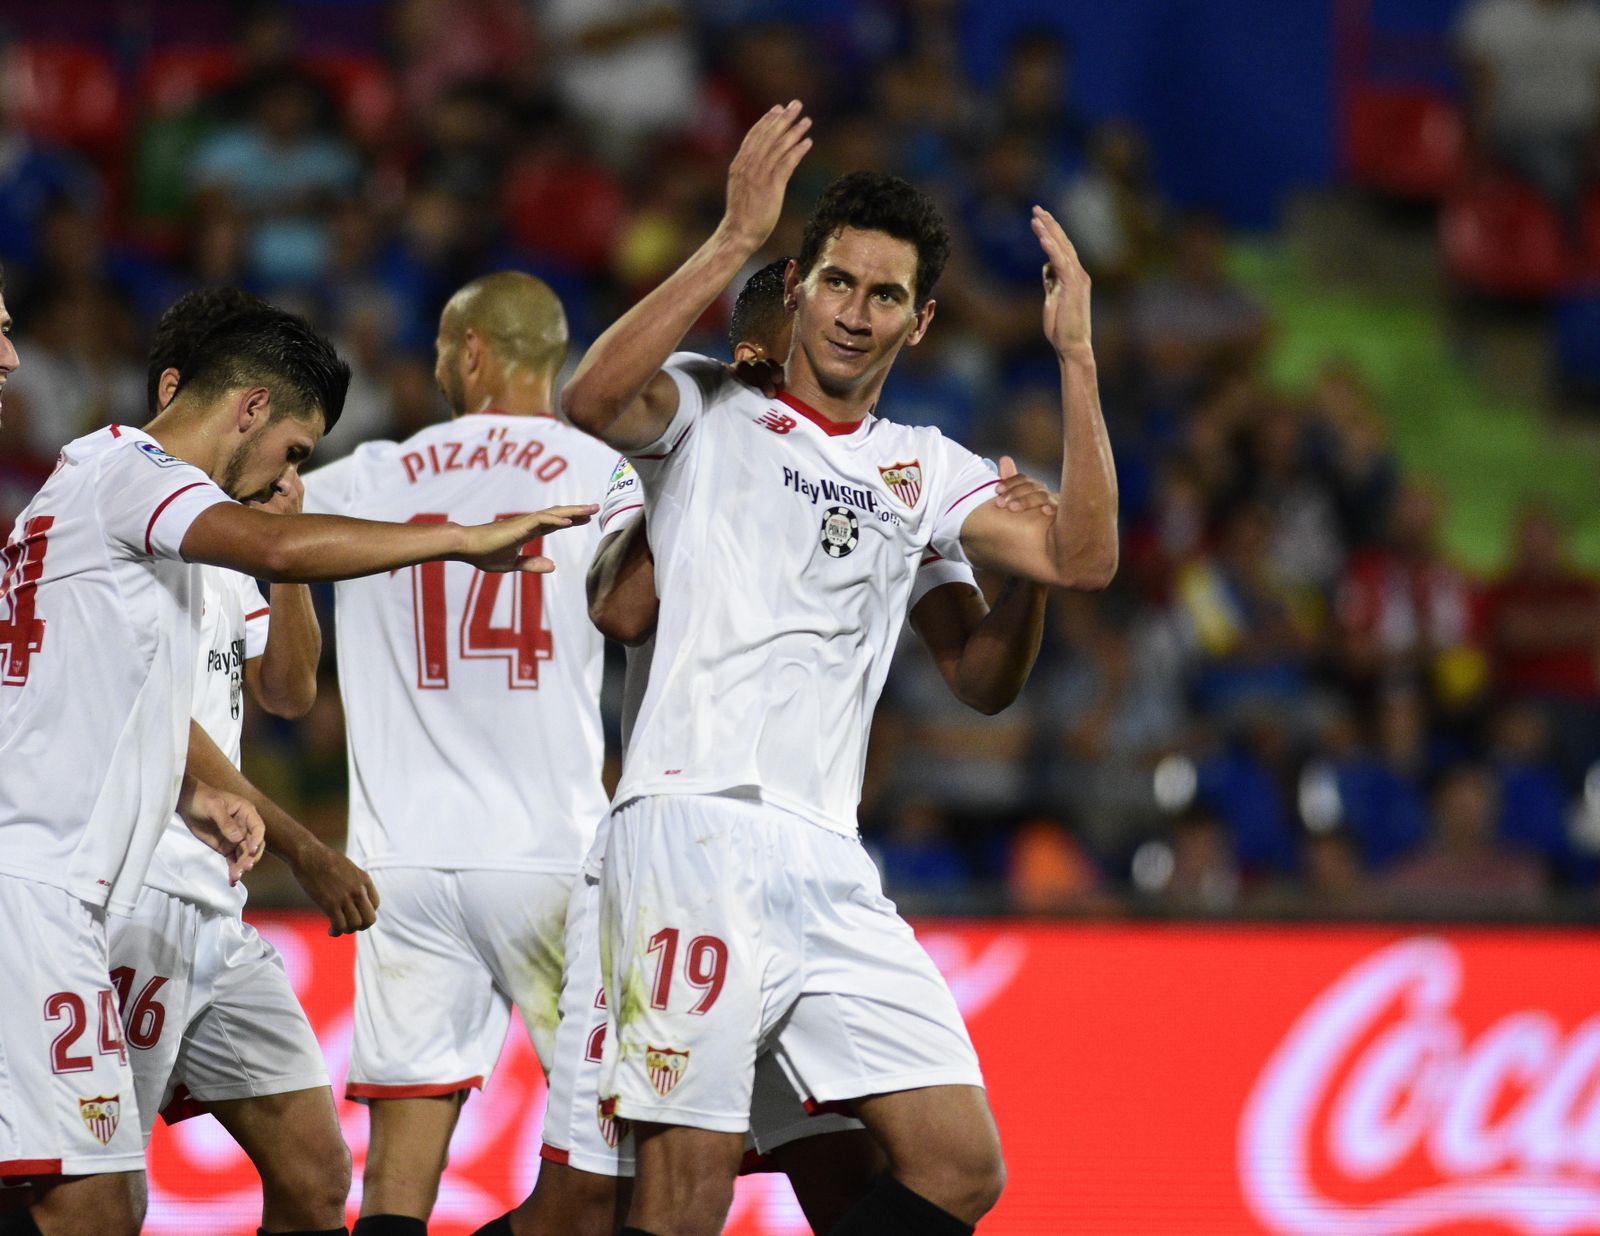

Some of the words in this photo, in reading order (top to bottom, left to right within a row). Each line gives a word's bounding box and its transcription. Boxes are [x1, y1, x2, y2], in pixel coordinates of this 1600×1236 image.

[401, 427, 568, 484] PIZARRO
[390, 513, 553, 690] 14
[110, 966, 169, 1050] 16
[647, 927, 729, 1016] 19
[44, 990, 127, 1074] 24
